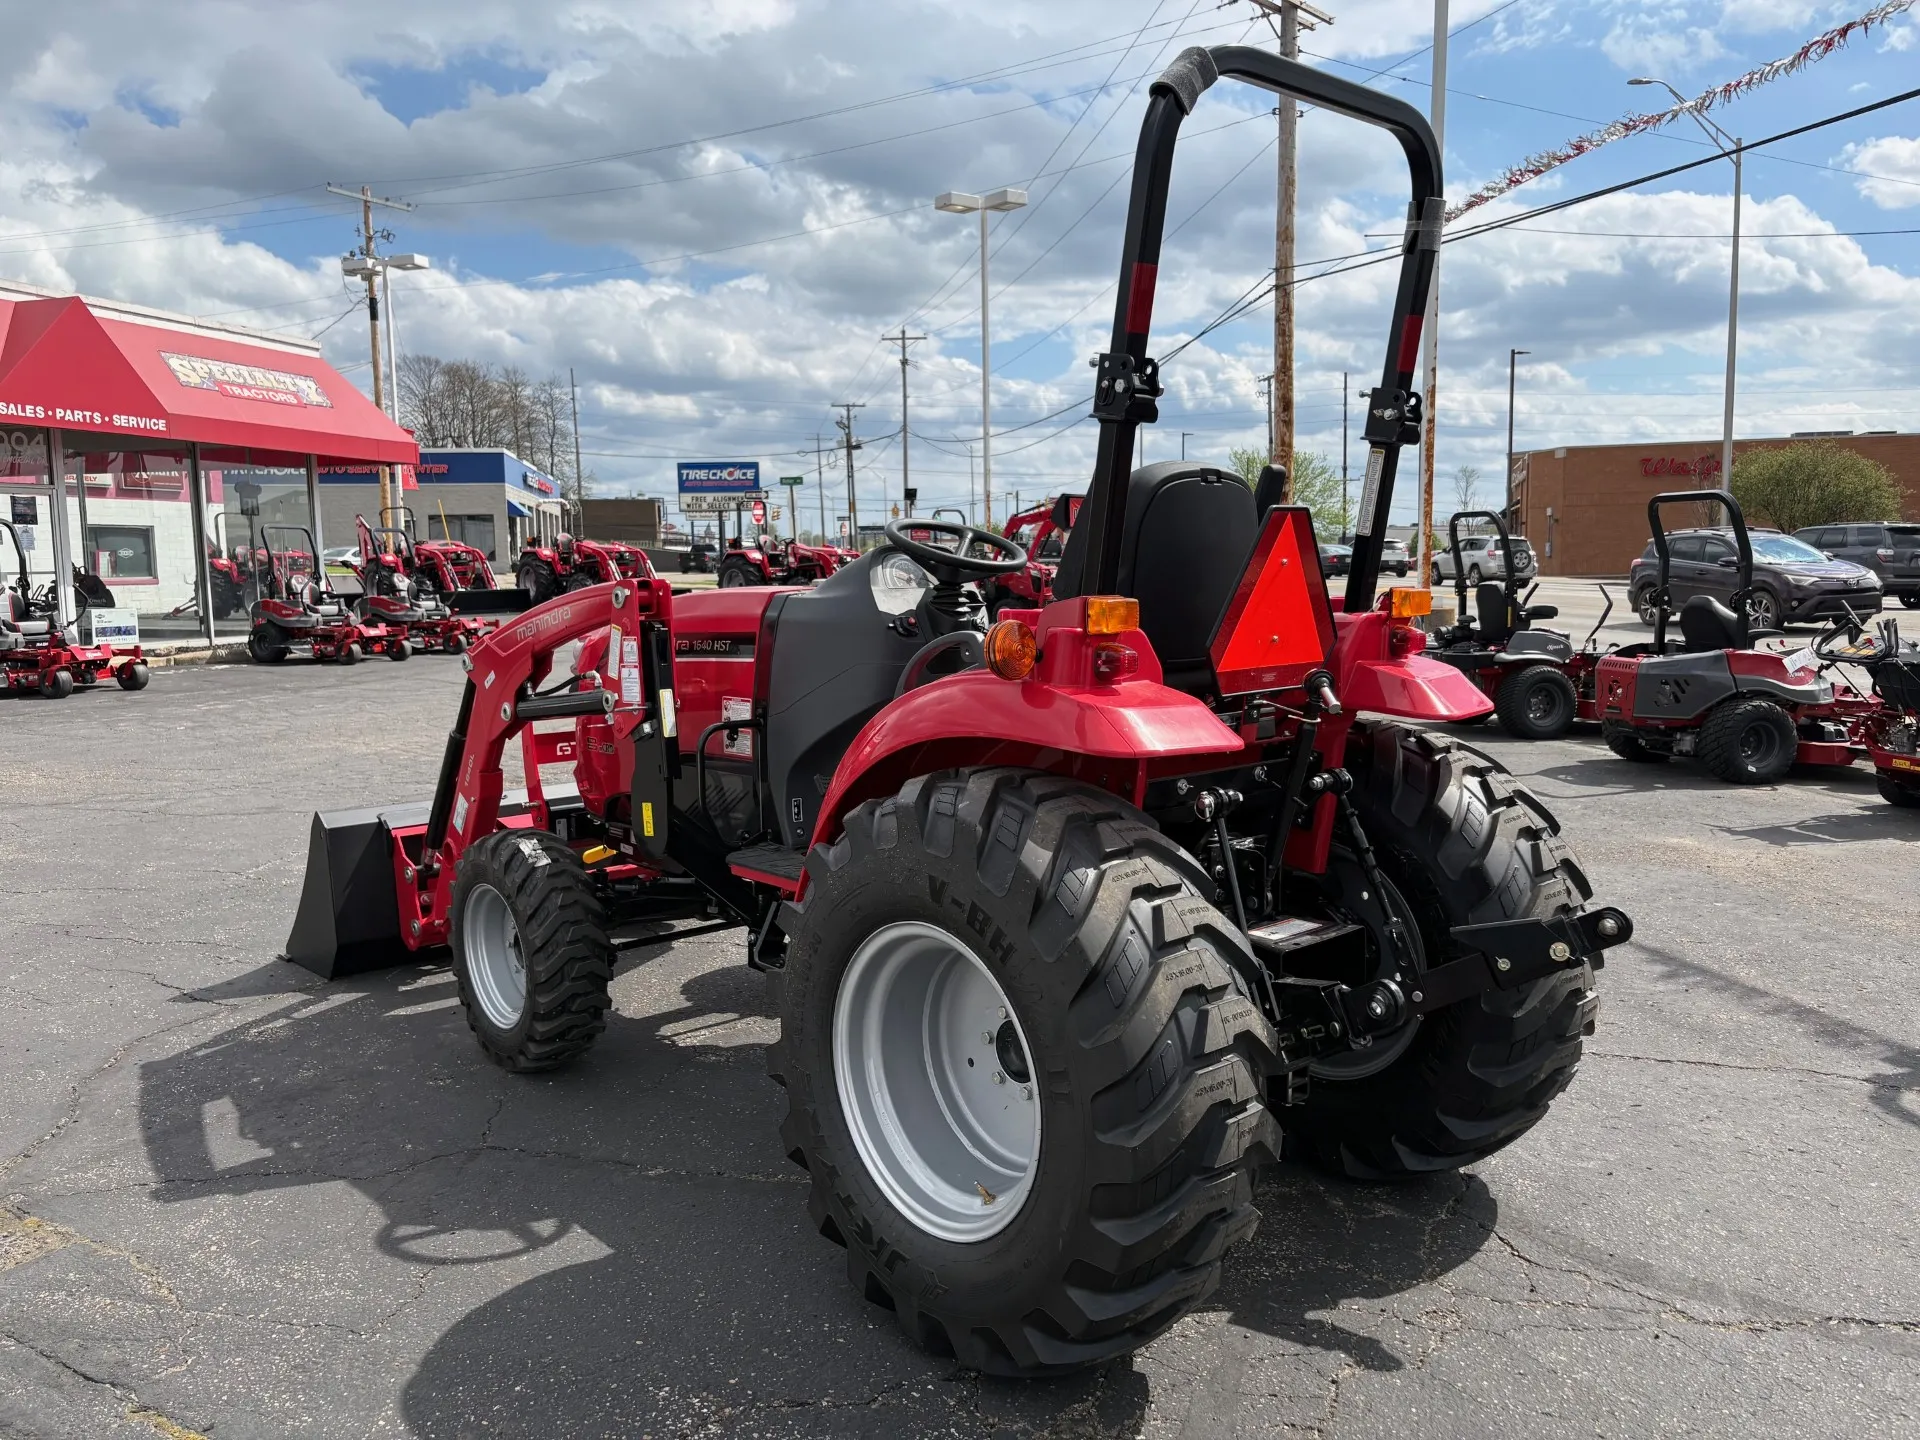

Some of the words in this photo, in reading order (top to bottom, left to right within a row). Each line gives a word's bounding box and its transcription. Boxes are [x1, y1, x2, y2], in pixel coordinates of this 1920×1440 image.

[168, 356, 325, 403] SPECIALTY
[223, 384, 298, 404] TRACTORS
[0, 402, 45, 419] SALES
[56, 408, 102, 425] PARTS
[113, 414, 167, 431] SERVICE
[516, 606, 572, 641] mahindra
[692, 640, 713, 651] 1640
[713, 640, 732, 652] HST
